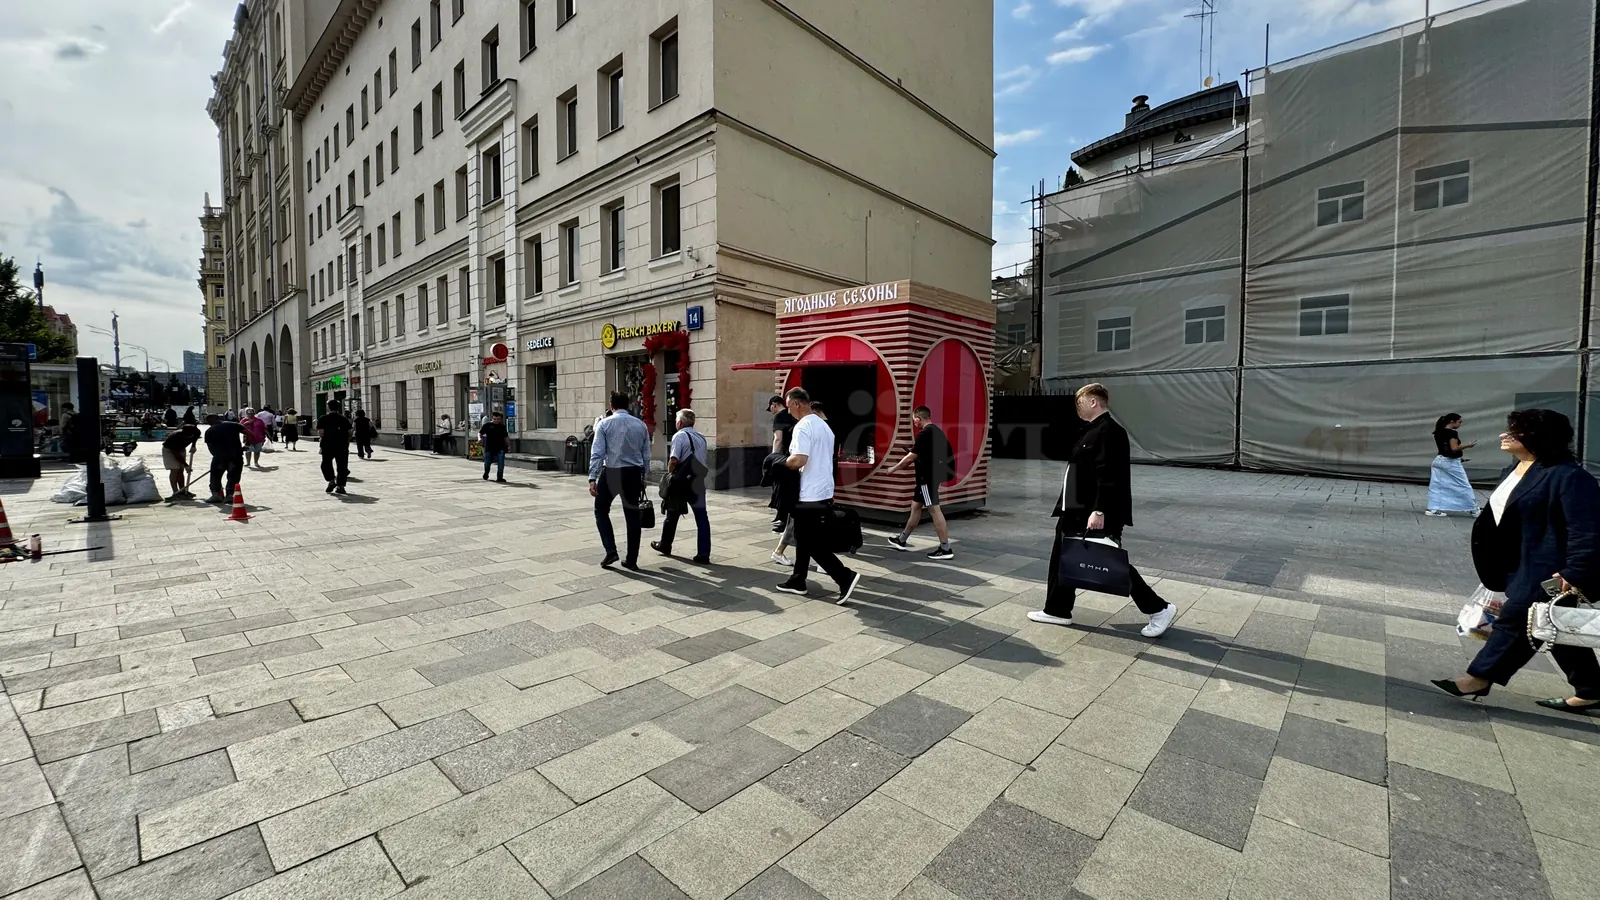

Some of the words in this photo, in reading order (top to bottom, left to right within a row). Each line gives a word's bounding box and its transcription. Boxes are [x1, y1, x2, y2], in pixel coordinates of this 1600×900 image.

[784, 292, 837, 313] ЯГОДНЫЕ
[843, 283, 898, 306] СЕЗОНЫ
[689, 312, 698, 325] 14
[616, 326, 645, 340] FRENCH
[646, 320, 678, 336] BAKERY
[526, 337, 552, 351] SEDELICE
